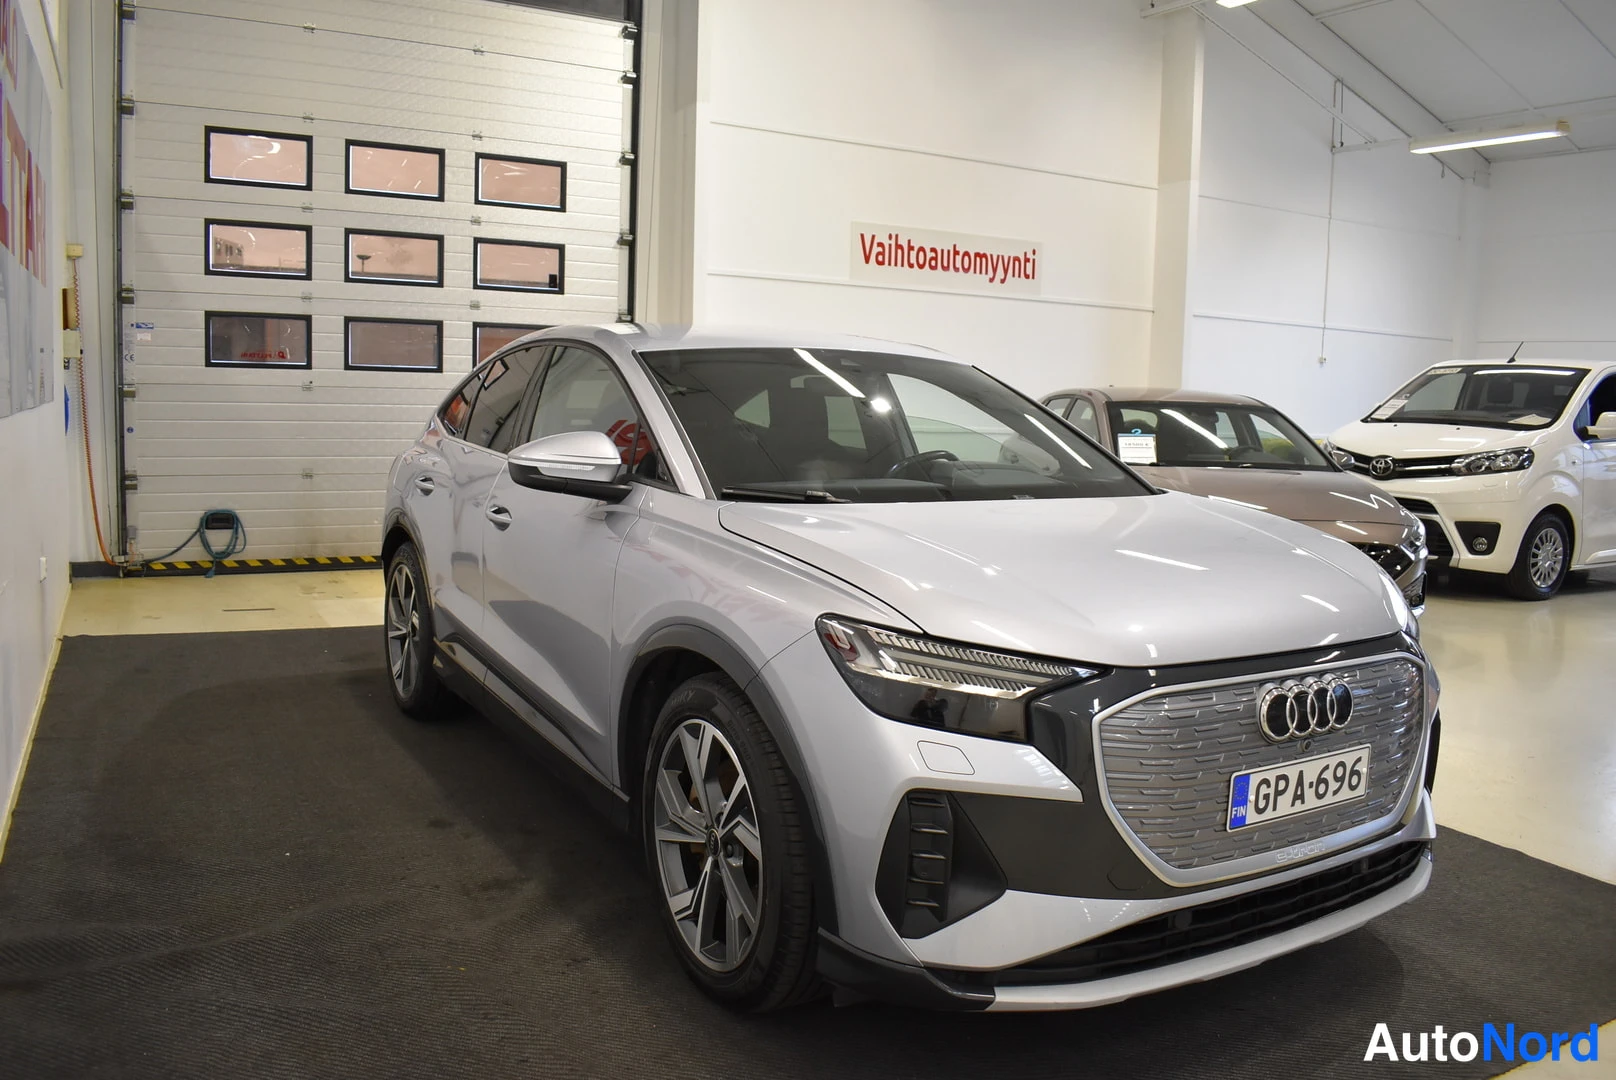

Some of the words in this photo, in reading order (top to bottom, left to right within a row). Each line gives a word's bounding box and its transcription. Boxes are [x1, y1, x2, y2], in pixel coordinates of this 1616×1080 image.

[859, 232, 1037, 285] Vaihtoautomyynti
[1231, 805, 1247, 819] FIN
[1253, 756, 1363, 815] GPA-696
